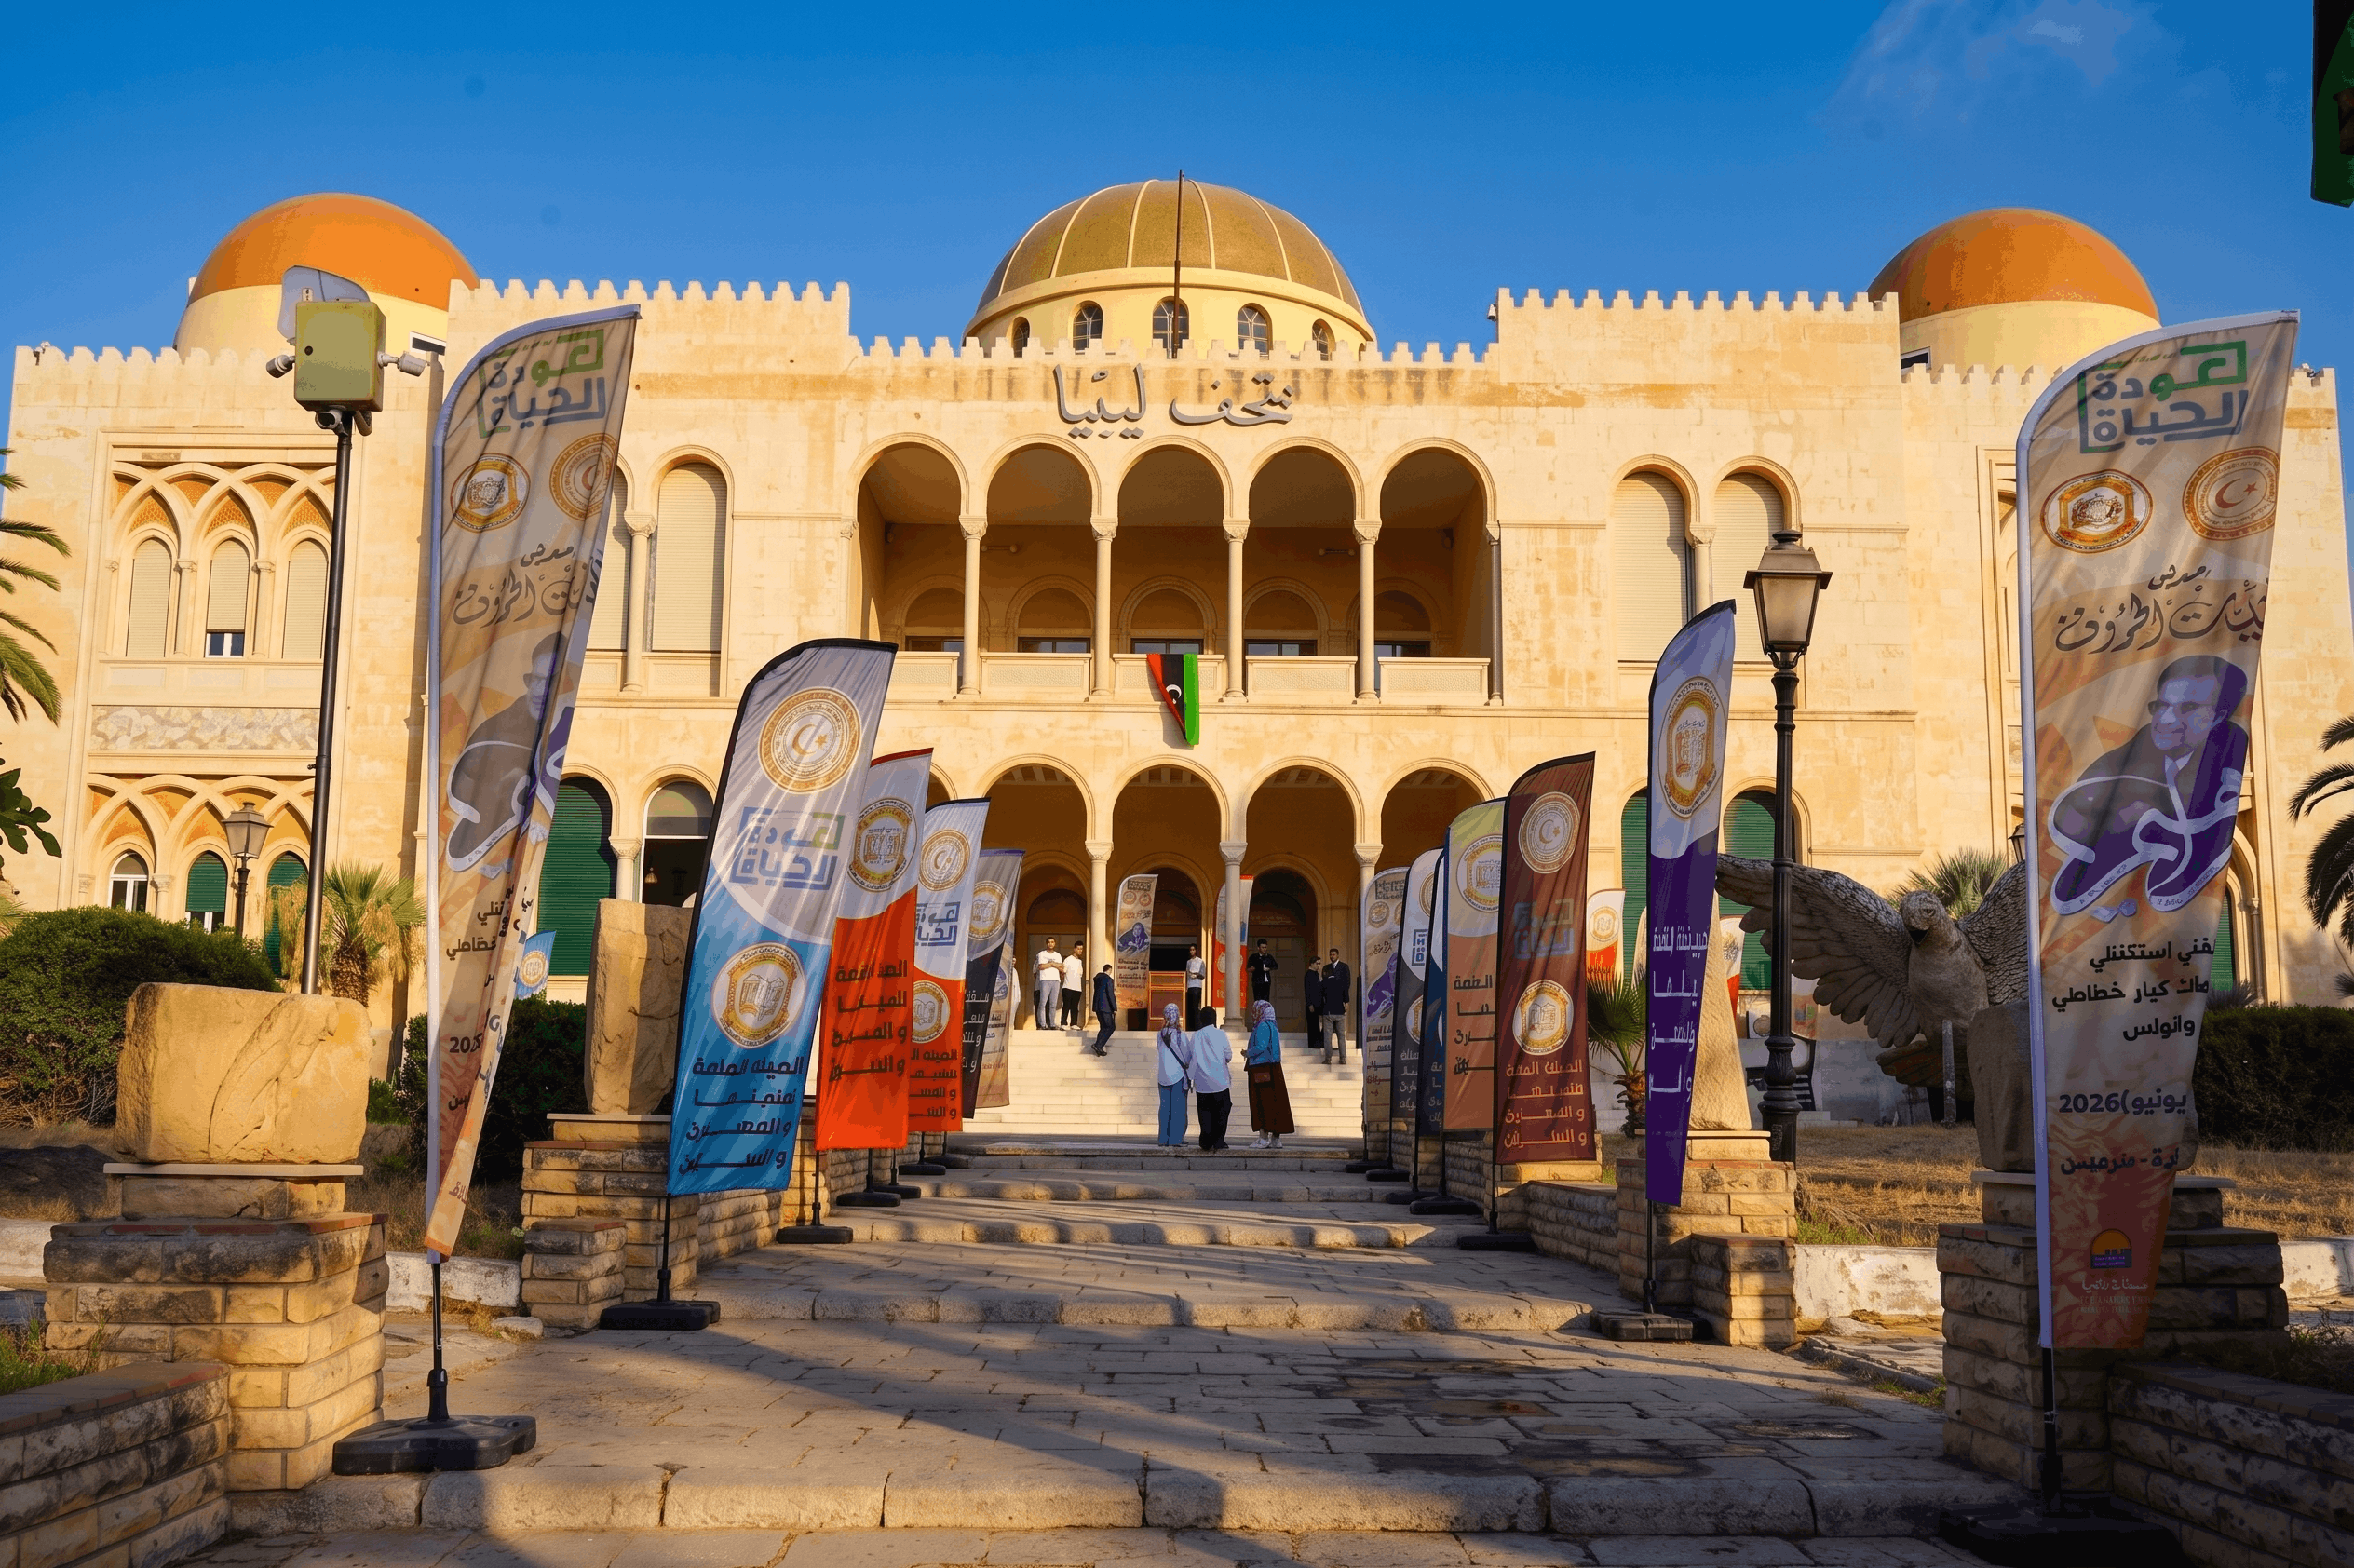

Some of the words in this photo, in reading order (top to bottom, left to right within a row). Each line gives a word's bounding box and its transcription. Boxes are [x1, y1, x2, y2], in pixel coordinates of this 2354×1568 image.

[2092, 340, 2248, 401] عودة
[491, 376, 606, 429] الحياة
[1052, 362, 1148, 440] ليبيا
[2092, 389, 2250, 446] الحياة
